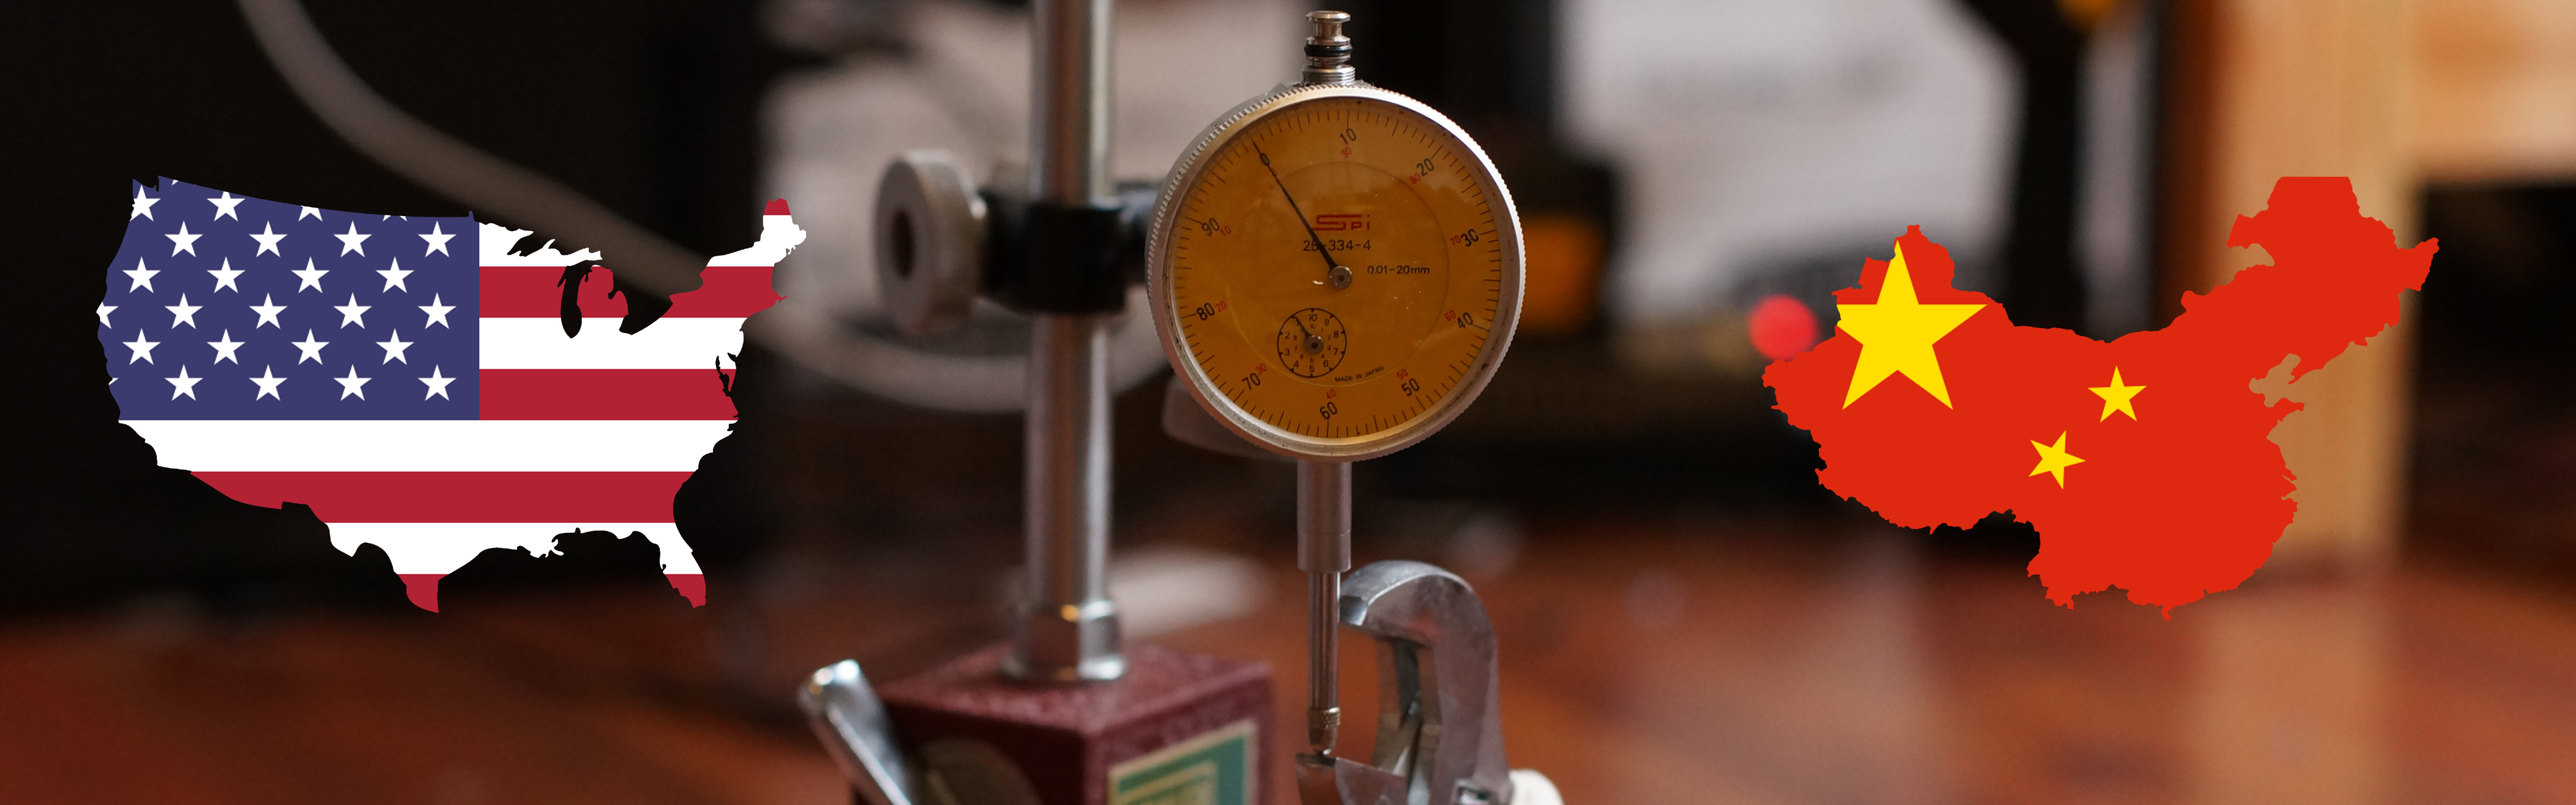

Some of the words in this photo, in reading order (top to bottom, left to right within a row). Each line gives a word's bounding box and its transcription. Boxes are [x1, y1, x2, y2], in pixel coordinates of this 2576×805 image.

[1340, 128, 1356, 145] 10
[1341, 146, 1353, 158] 90
[1417, 158, 1434, 176] 20
[1410, 173, 1421, 184] 80
[1201, 218, 1219, 236] 90
[1220, 226, 1231, 237] 10
[1449, 235, 1461, 245] 70
[1461, 229, 1479, 246] 30
[1303, 240, 1371, 251] 25-334-4
[1196, 303, 1215, 320] 80
[1216, 300, 1227, 312] 20
[1444, 309, 1456, 321] 60
[1457, 312, 1473, 329] 40
[1255, 363, 1267, 374] 30
[1365, 366, 1384, 377] JAPAN
[1396, 369, 1408, 380] 50
[1241, 372, 1261, 390] 70
[1401, 378, 1420, 396] 50
[1326, 389, 1337, 399] 40
[1319, 402, 1337, 420] 60
